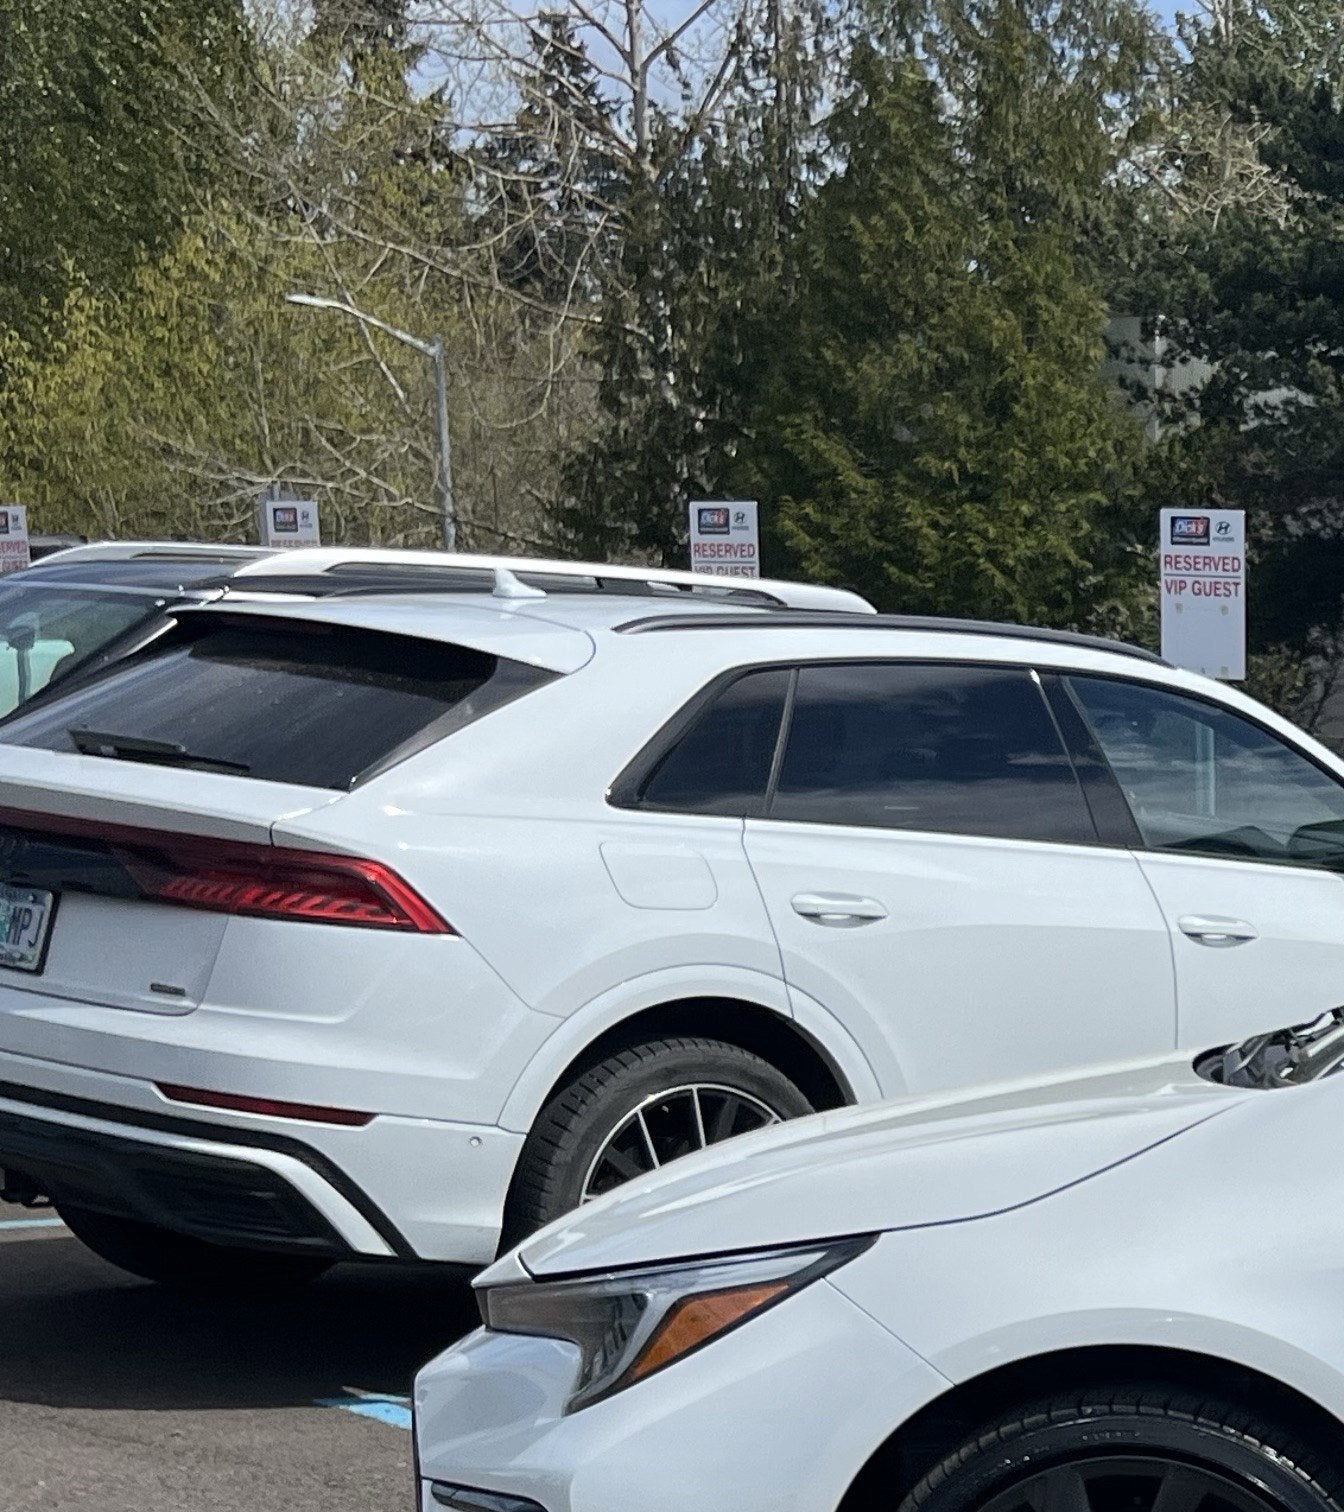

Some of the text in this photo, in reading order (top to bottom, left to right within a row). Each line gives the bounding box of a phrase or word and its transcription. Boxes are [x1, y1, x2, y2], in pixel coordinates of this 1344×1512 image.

[694, 543, 755, 558] RESERVED
[1164, 554, 1241, 573] RESERVED
[1165, 578, 1241, 598] VIP GUEST
